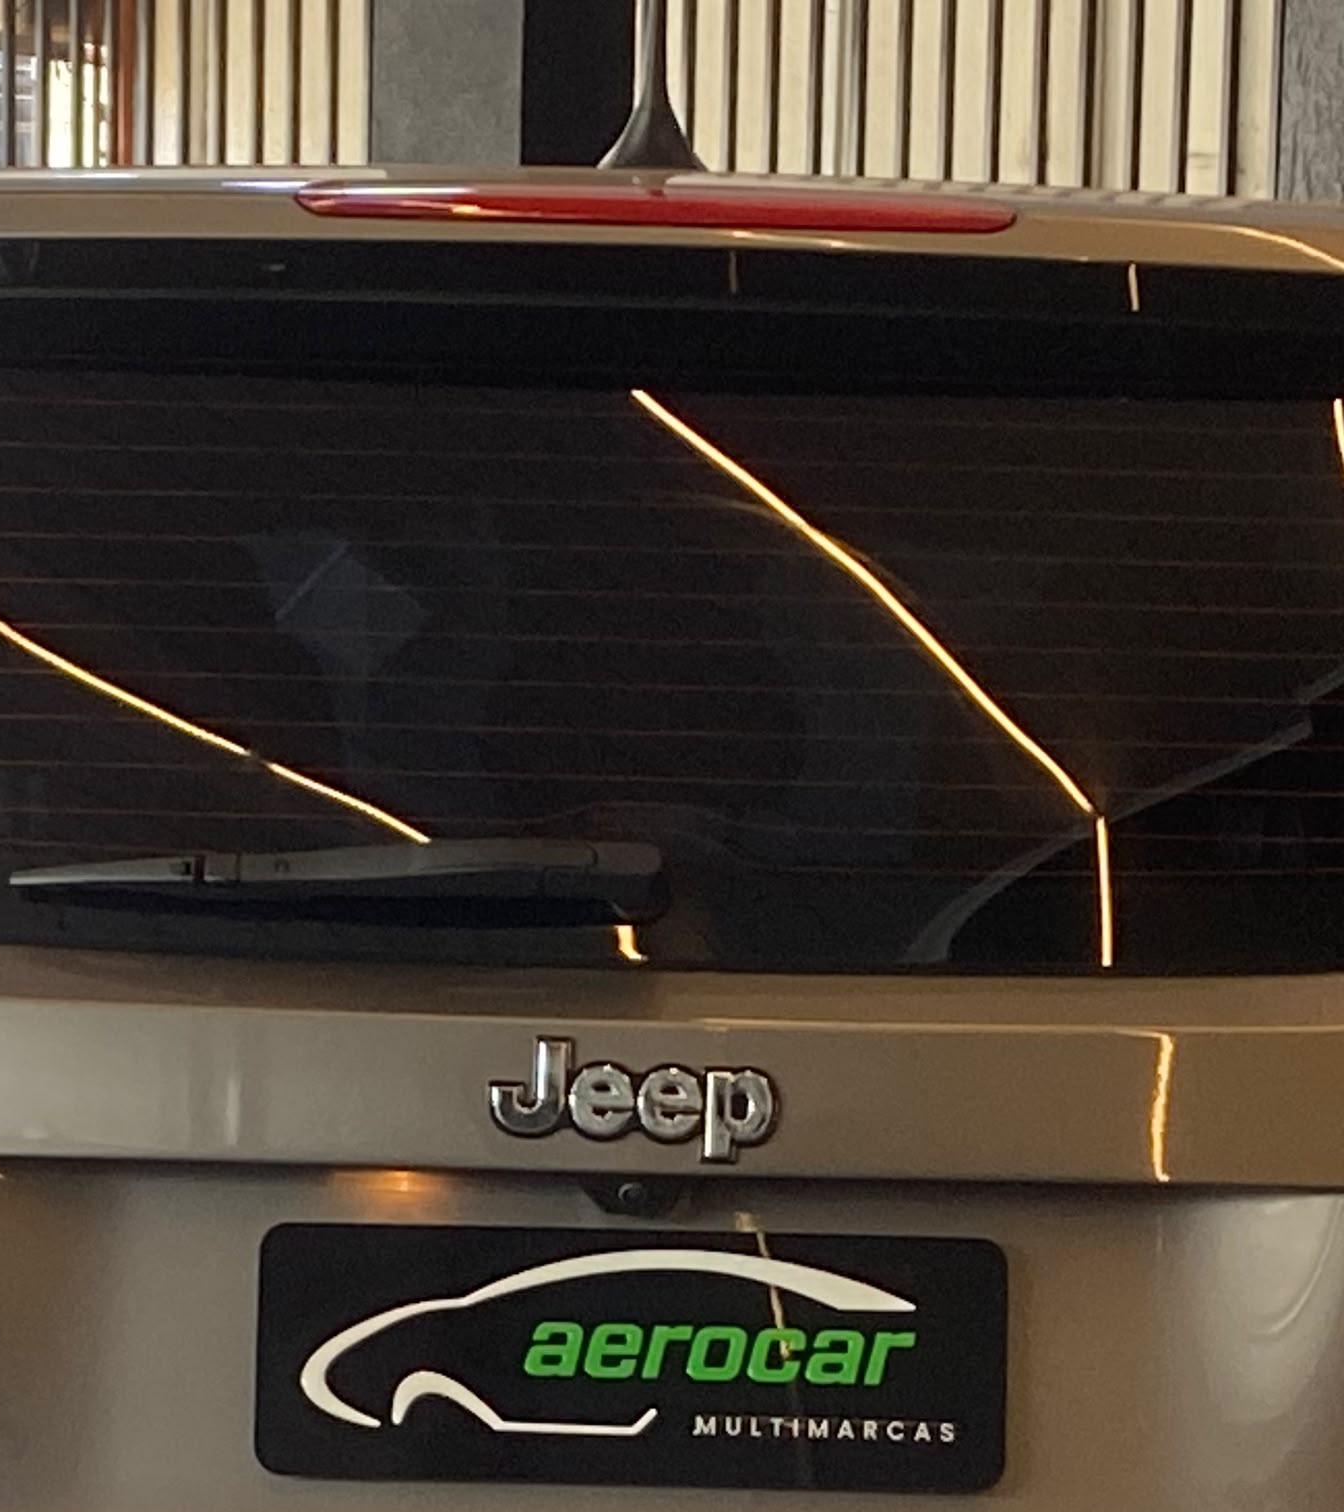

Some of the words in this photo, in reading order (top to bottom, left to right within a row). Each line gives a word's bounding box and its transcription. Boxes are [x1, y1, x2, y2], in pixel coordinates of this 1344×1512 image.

[488, 1036, 780, 1164] Jeep
[523, 1320, 916, 1387] aerocar
[692, 1414, 956, 1443] MULTIMARCAS
